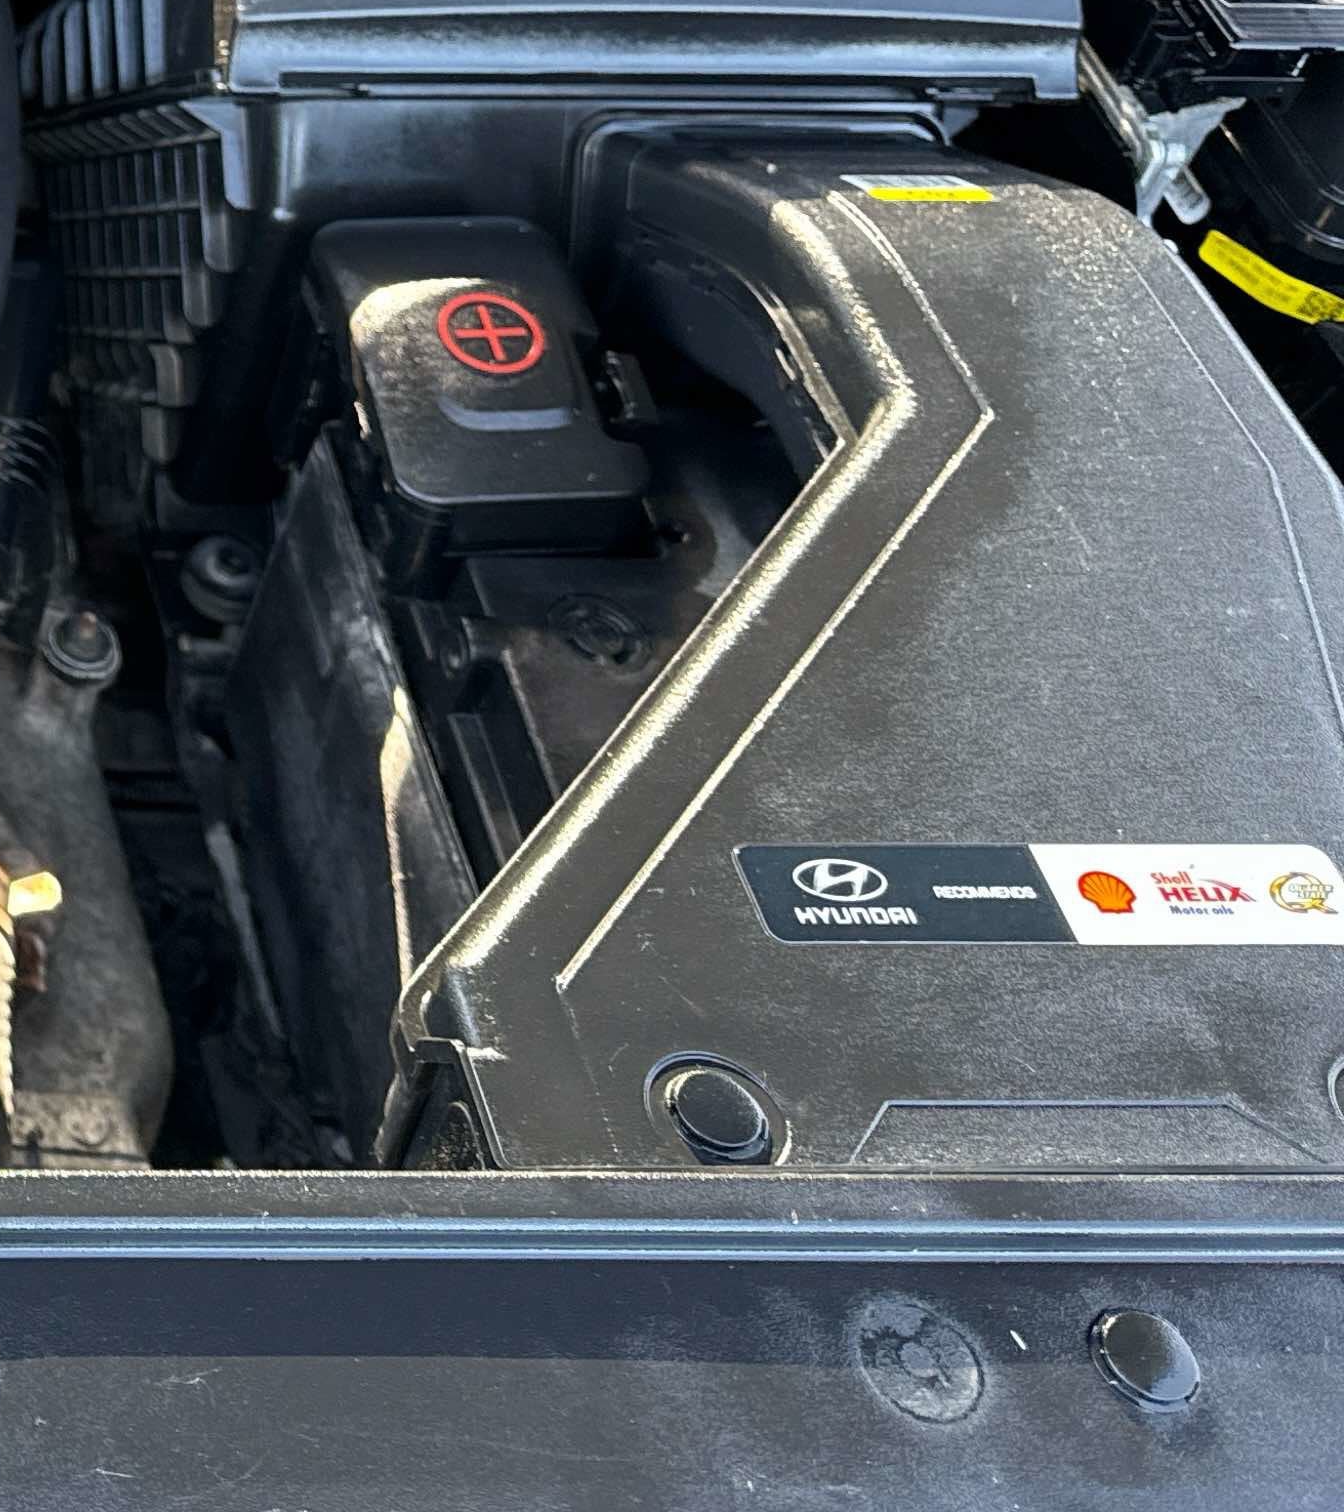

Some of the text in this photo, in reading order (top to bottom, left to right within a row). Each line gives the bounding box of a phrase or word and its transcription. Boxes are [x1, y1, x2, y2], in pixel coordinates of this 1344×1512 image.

[1150, 871, 1193, 885] Shell
[1157, 886, 1255, 902] HELIX
[793, 907, 918, 926] HYUNDAI
[1169, 905, 1234, 915] Motor oils
